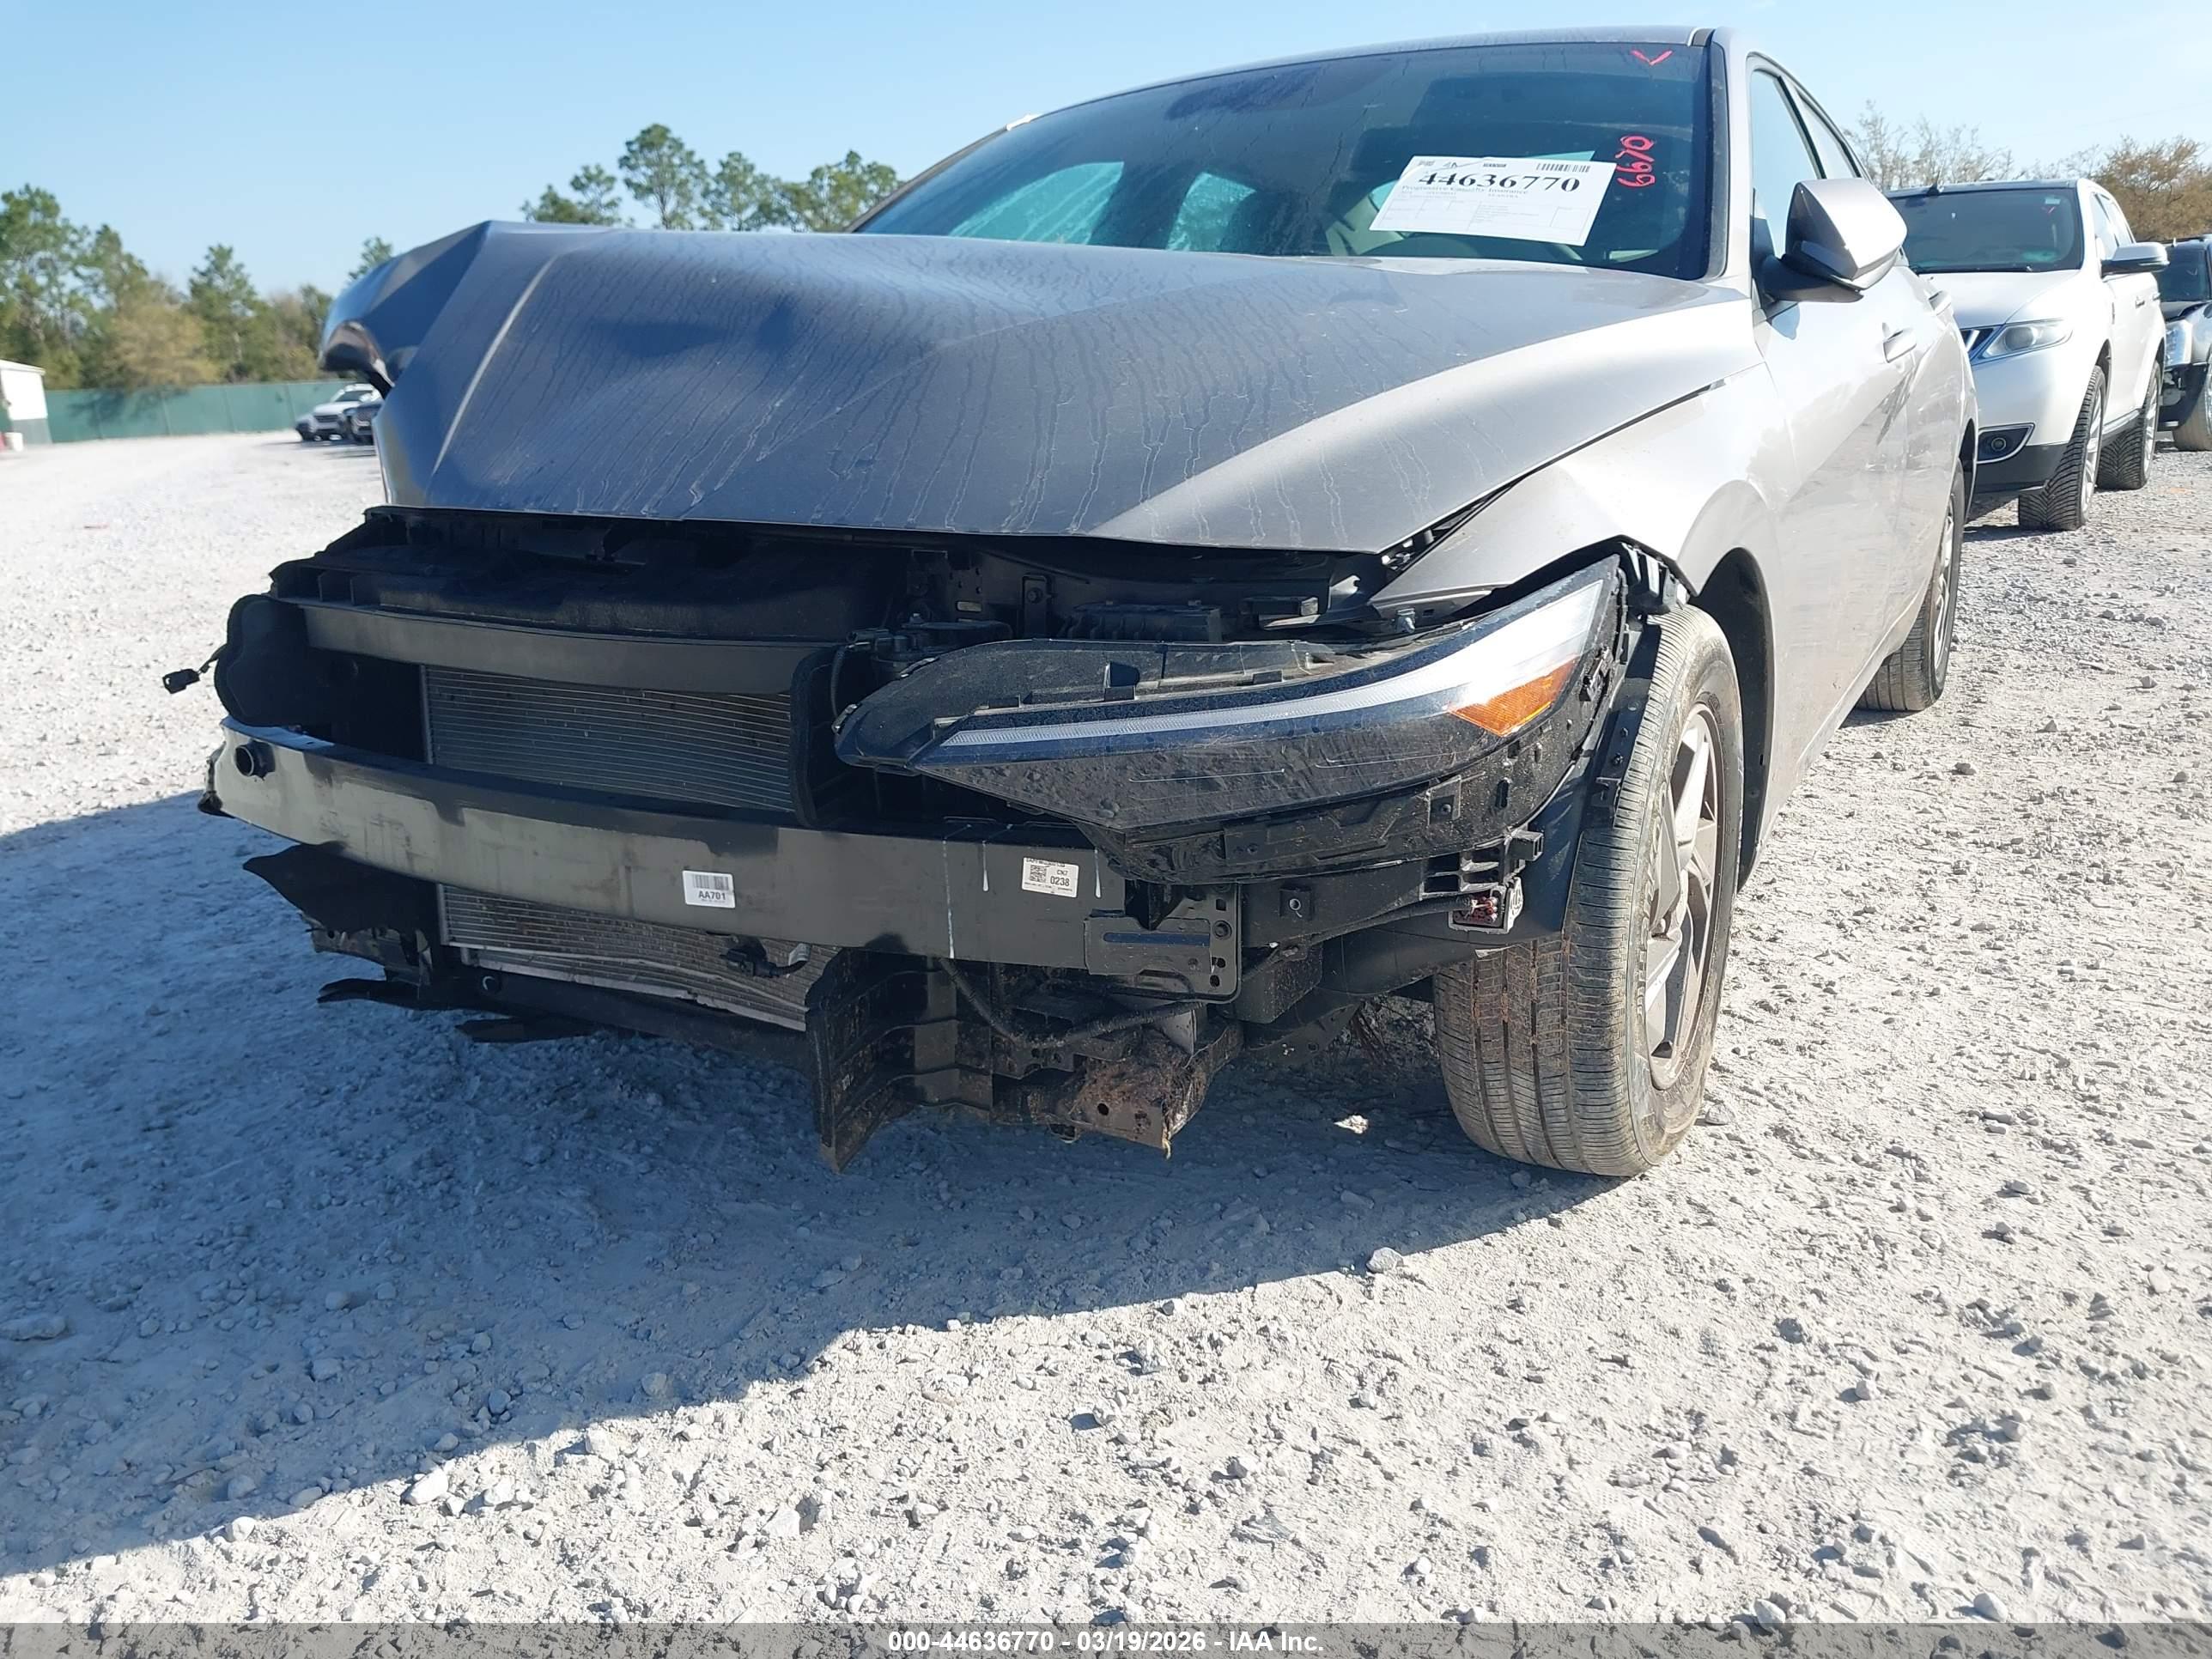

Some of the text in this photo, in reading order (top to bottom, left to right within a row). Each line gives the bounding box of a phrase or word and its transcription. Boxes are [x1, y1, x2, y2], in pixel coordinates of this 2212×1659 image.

[1419, 172, 1580, 191] 44636770
[1049, 876, 1070, 886] 0238
[698, 890, 726, 900] AA701
